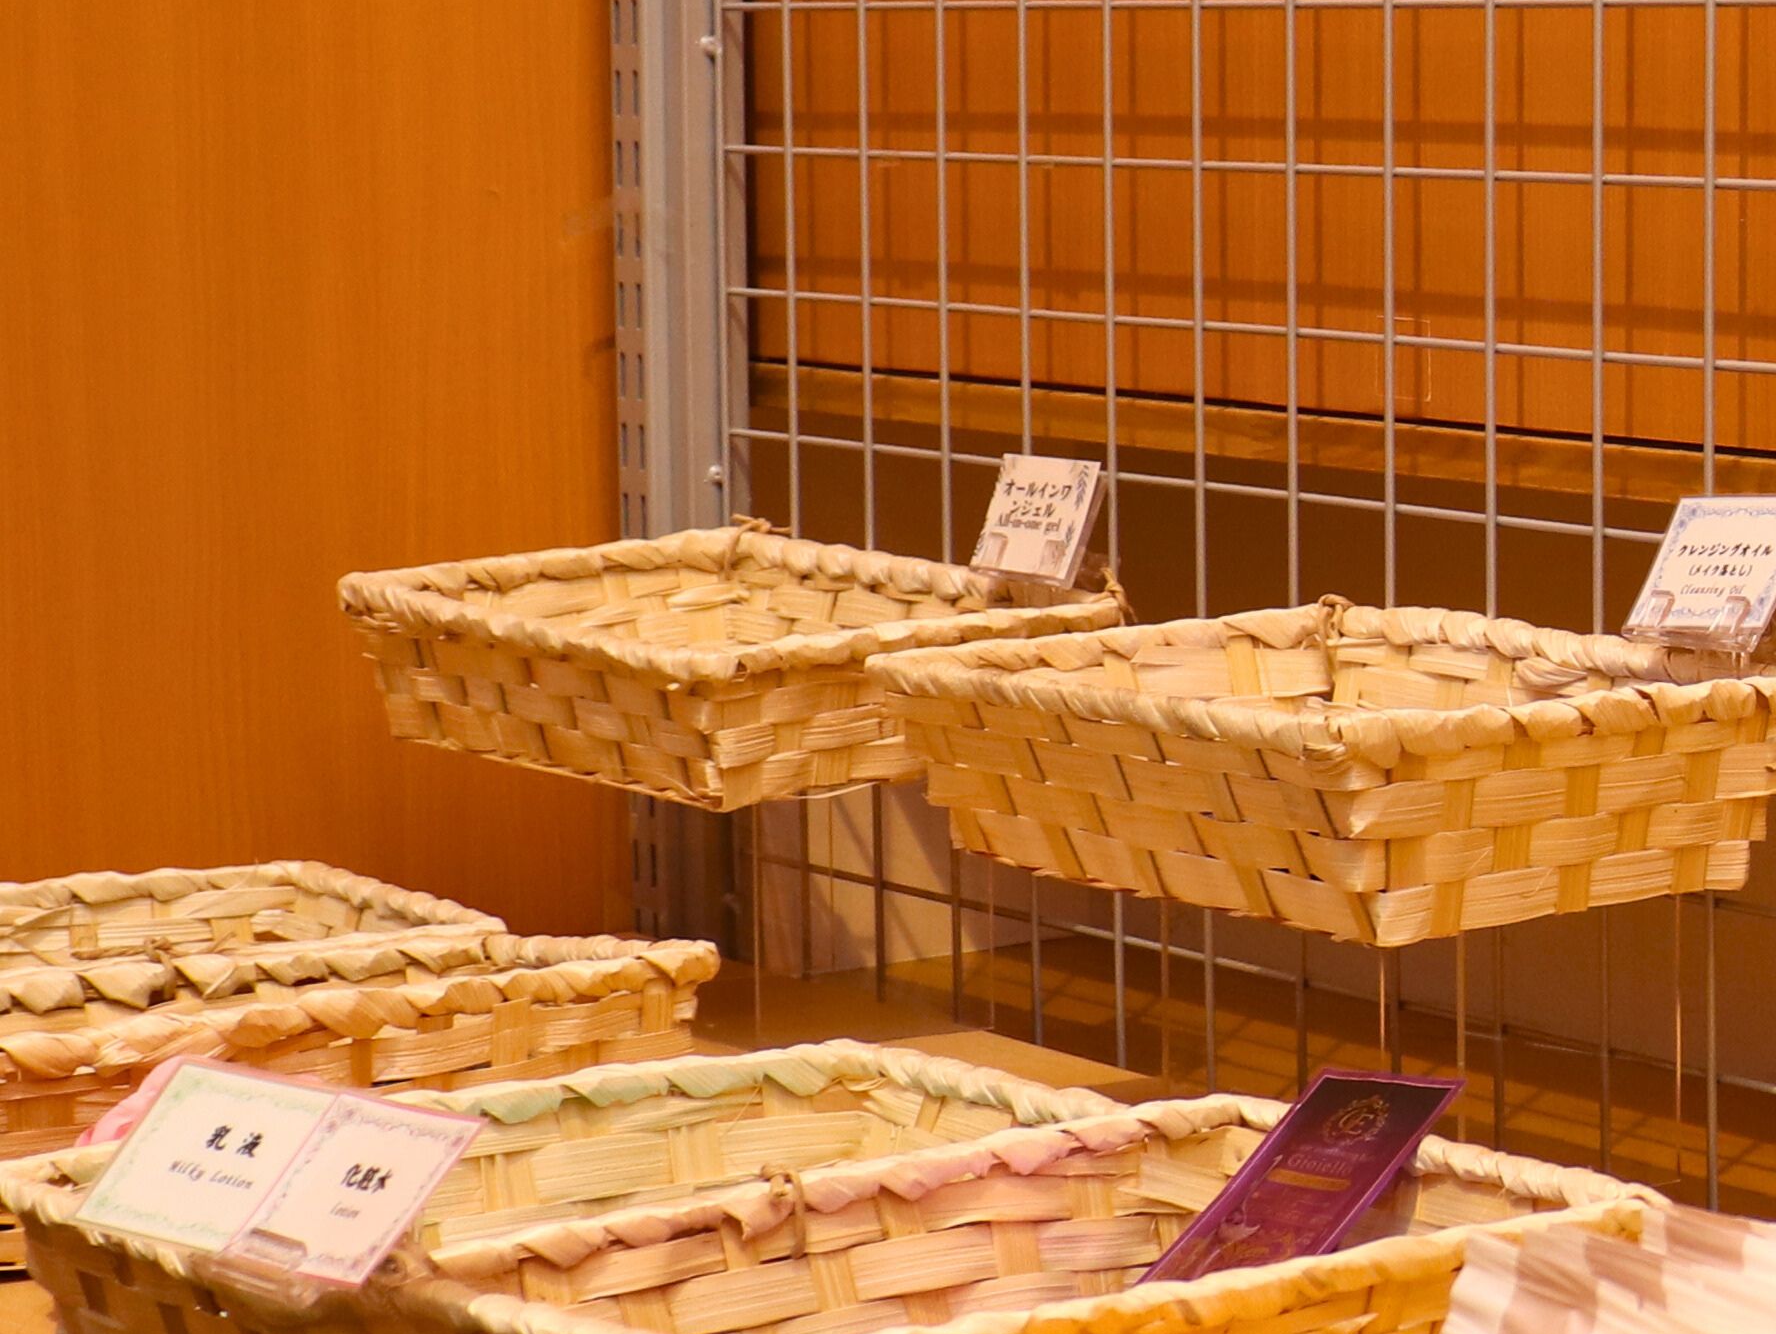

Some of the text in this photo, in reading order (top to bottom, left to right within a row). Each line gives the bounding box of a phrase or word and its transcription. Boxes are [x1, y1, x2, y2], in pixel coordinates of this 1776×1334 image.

[1677, 542, 1774, 558] クレンジングオイル
